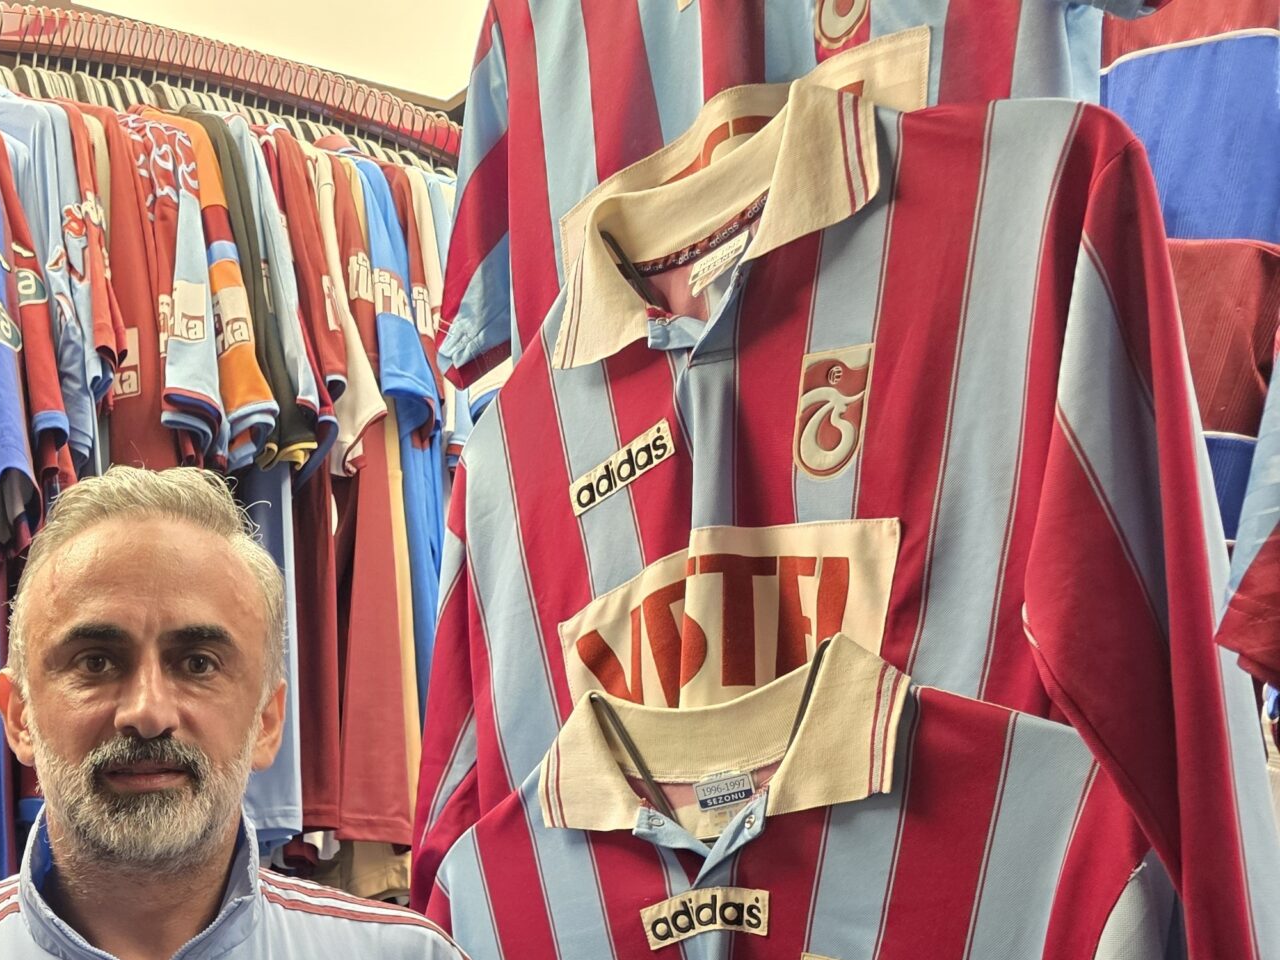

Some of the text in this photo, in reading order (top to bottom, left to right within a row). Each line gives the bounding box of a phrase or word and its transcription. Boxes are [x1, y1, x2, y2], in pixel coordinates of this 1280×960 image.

[709, 221, 740, 249] adidas
[576, 427, 668, 508] adidas
[702, 778, 746, 797] 1996-1997
[706, 791, 746, 806] SEZONU
[651, 894, 762, 941] adidas
